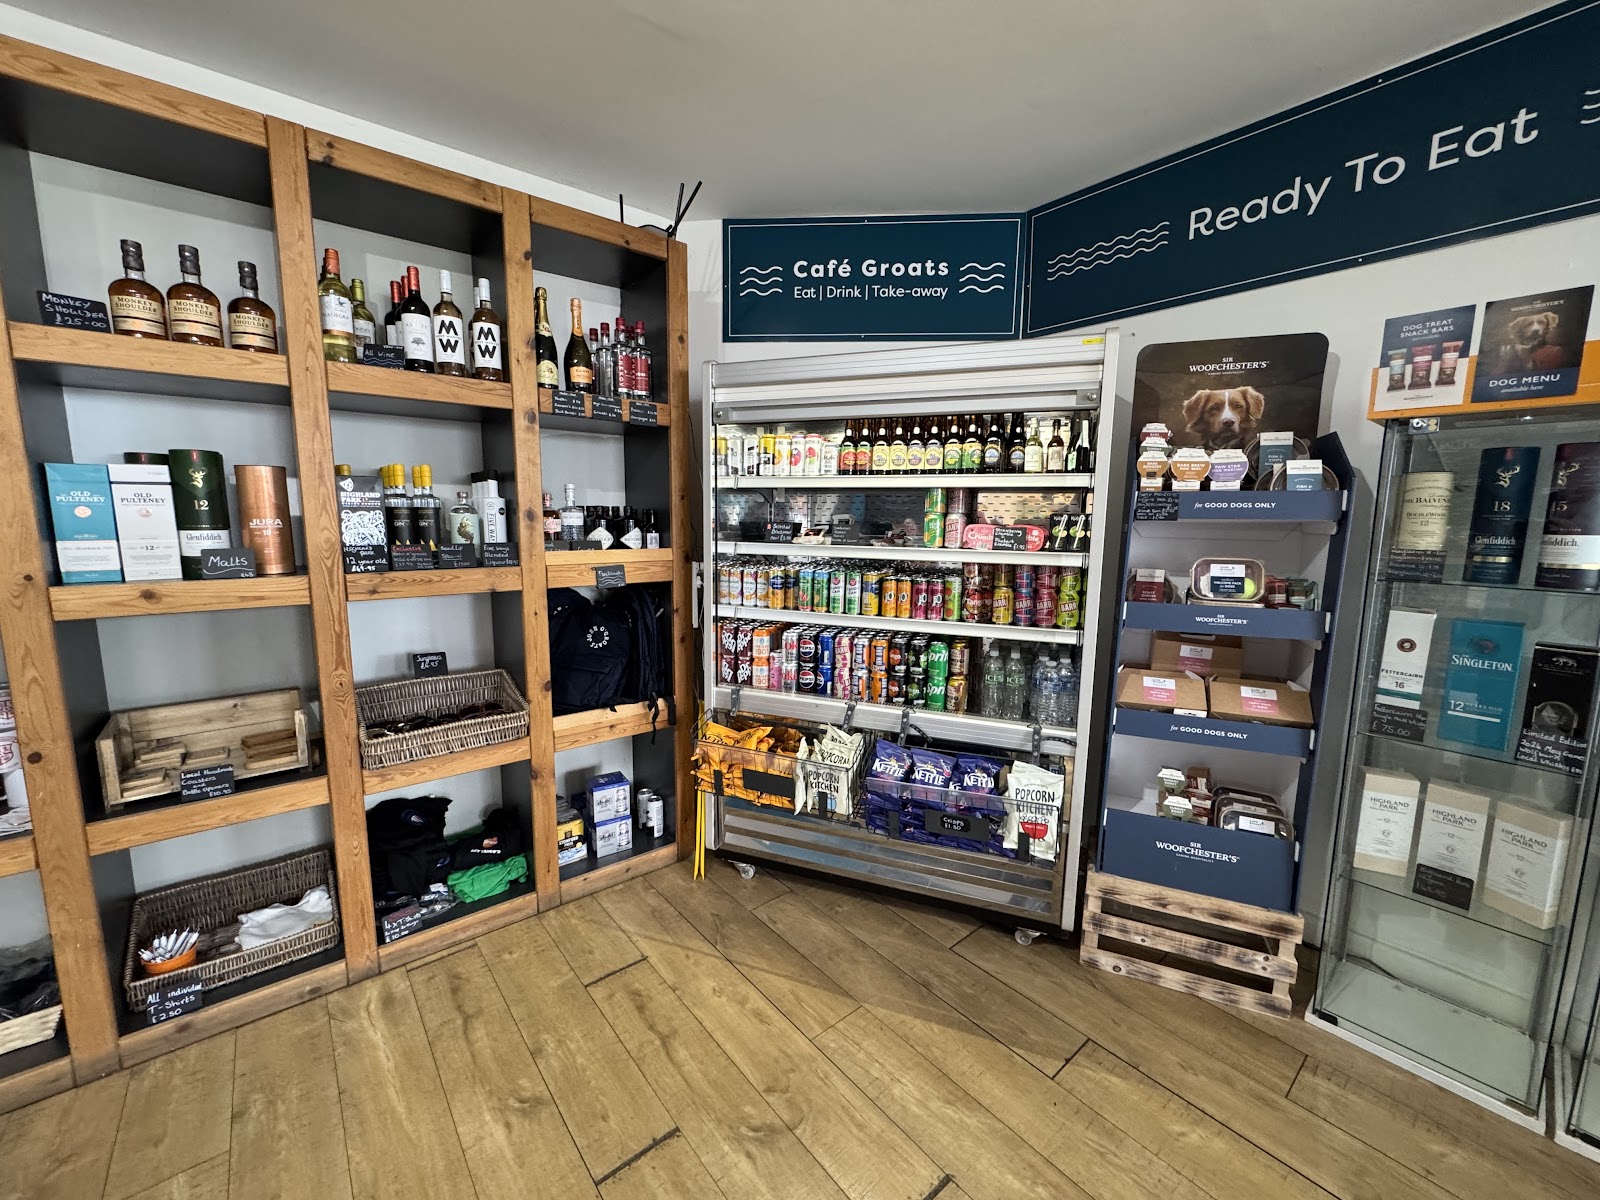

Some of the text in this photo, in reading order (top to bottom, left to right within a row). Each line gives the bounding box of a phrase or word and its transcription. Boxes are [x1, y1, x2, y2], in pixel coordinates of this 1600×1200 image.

[1187, 106, 1539, 240] Ready To Eat
[793, 258, 949, 278] Café Groats
[794, 285, 949, 300] Eat Drink Take-away
[117, 296, 153, 307] MONKEY
[175, 300, 210, 311] MONKEY
[115, 302, 158, 313] SHOULDER
[173, 305, 213, 317] SHOULDER
[233, 319, 269, 328] SHOULDER
[235, 314, 266, 323] MONKEY
[1403, 318, 1453, 331] DOG TREAT
[1400, 324, 1454, 338] SNACK BARS
[1189, 360, 1268, 373] WOOFCHESTER'S
[1489, 373, 1560, 388] DOG MENU
[56, 495, 106, 503] PULTENEY
[193, 499, 210, 511] 12
[1194, 501, 1204, 509] for
[1493, 500, 1511, 512] 18
[1551, 501, 1568, 512] 15
[249, 518, 283, 526] JURA
[186, 532, 223, 542] Glenfiddich
[968, 531, 993, 541] Crumb
[1474, 535, 1516, 545] Glenfiddich
[208, 555, 248, 567] Malts
[346, 557, 356, 565] 12
[357, 558, 374, 566] year
[1015, 600, 1031, 609] BARR
[1036, 601, 1053, 610] BARR
[1060, 602, 1077, 612] BARR
[1195, 616, 1248, 625] WOOFCHESTER'S
[1451, 654, 1513, 672] SINGLETON
[1381, 668, 1423, 679] FETTERCAIRN
[1394, 681, 1405, 689] 16
[1449, 700, 1465, 711] 12
[1170, 724, 1248, 740] for GOOD DOGS ONLY
[1522, 729, 1556, 743] Limited
[1516, 753, 1538, 763] Local
[872, 758, 905, 778] KETTLE
[181, 770, 201, 779] Local
[808, 770, 840, 784] POPCORN
[911, 766, 946, 786] KETTLE
[181, 776, 217, 785] Coasters
[810, 781, 839, 794] KITCHEN
[1015, 788, 1056, 803] POPCORN
[1370, 797, 1410, 808] HIGHLAND
[1016, 802, 1054, 816] KITCHEN
[1432, 808, 1477, 825] HIGHLAND
[1442, 816, 1465, 827] PARK
[1501, 828, 1548, 849] HIGHLAND
[1511, 839, 1535, 850] PARK
[1155, 840, 1239, 863] WOOFCHESTER'S
